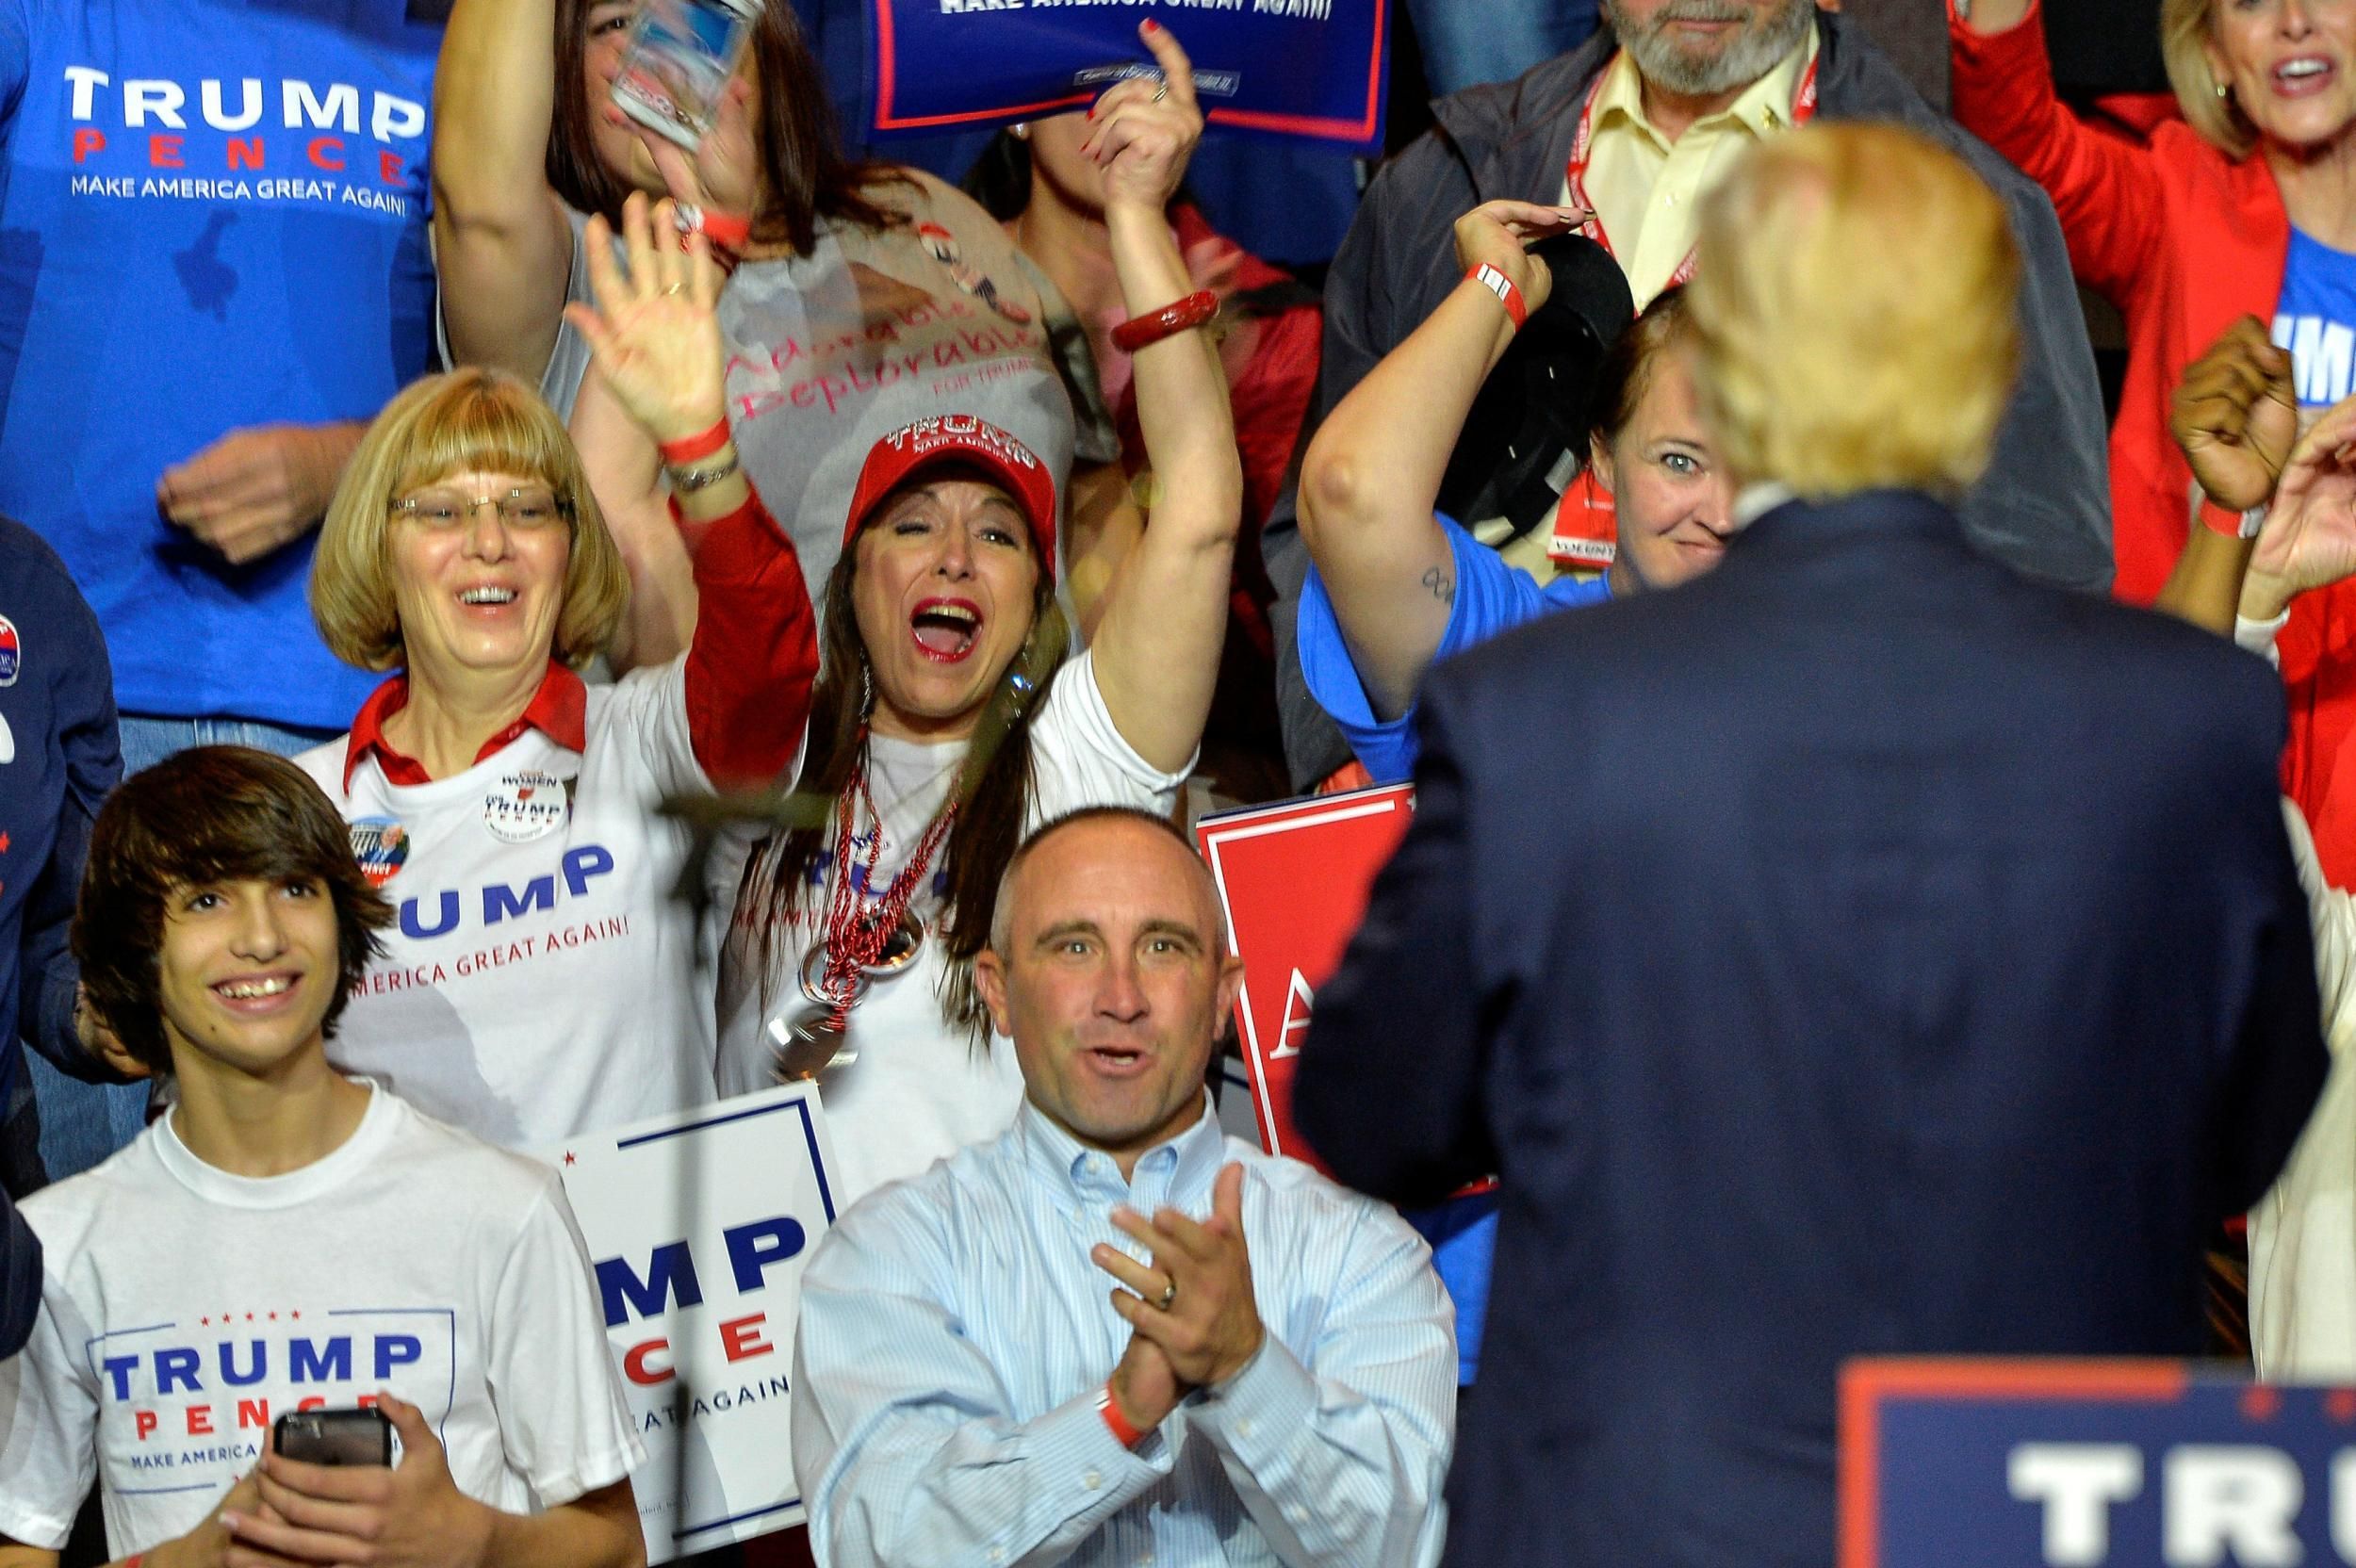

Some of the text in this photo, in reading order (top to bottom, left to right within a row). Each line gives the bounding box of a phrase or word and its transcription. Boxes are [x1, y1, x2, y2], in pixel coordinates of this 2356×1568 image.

[63, 65, 426, 143] TRUMP
[73, 127, 408, 187] PENCE
[71, 175, 406, 217] MAKE AMERICA GREAT AGAIN!
[734, 326, 1040, 419] Deplorable
[885, 415, 1037, 470] TRUMP
[486, 802, 561, 815] TRUMP
[501, 776, 558, 788] WOMEN
[399, 844, 614, 939] UMP
[352, 914, 630, 1001] MERICA GREAT AGAIN!
[104, 1334, 423, 1402] TRUMP
[131, 1443, 257, 1470] MAKE AMERICA
